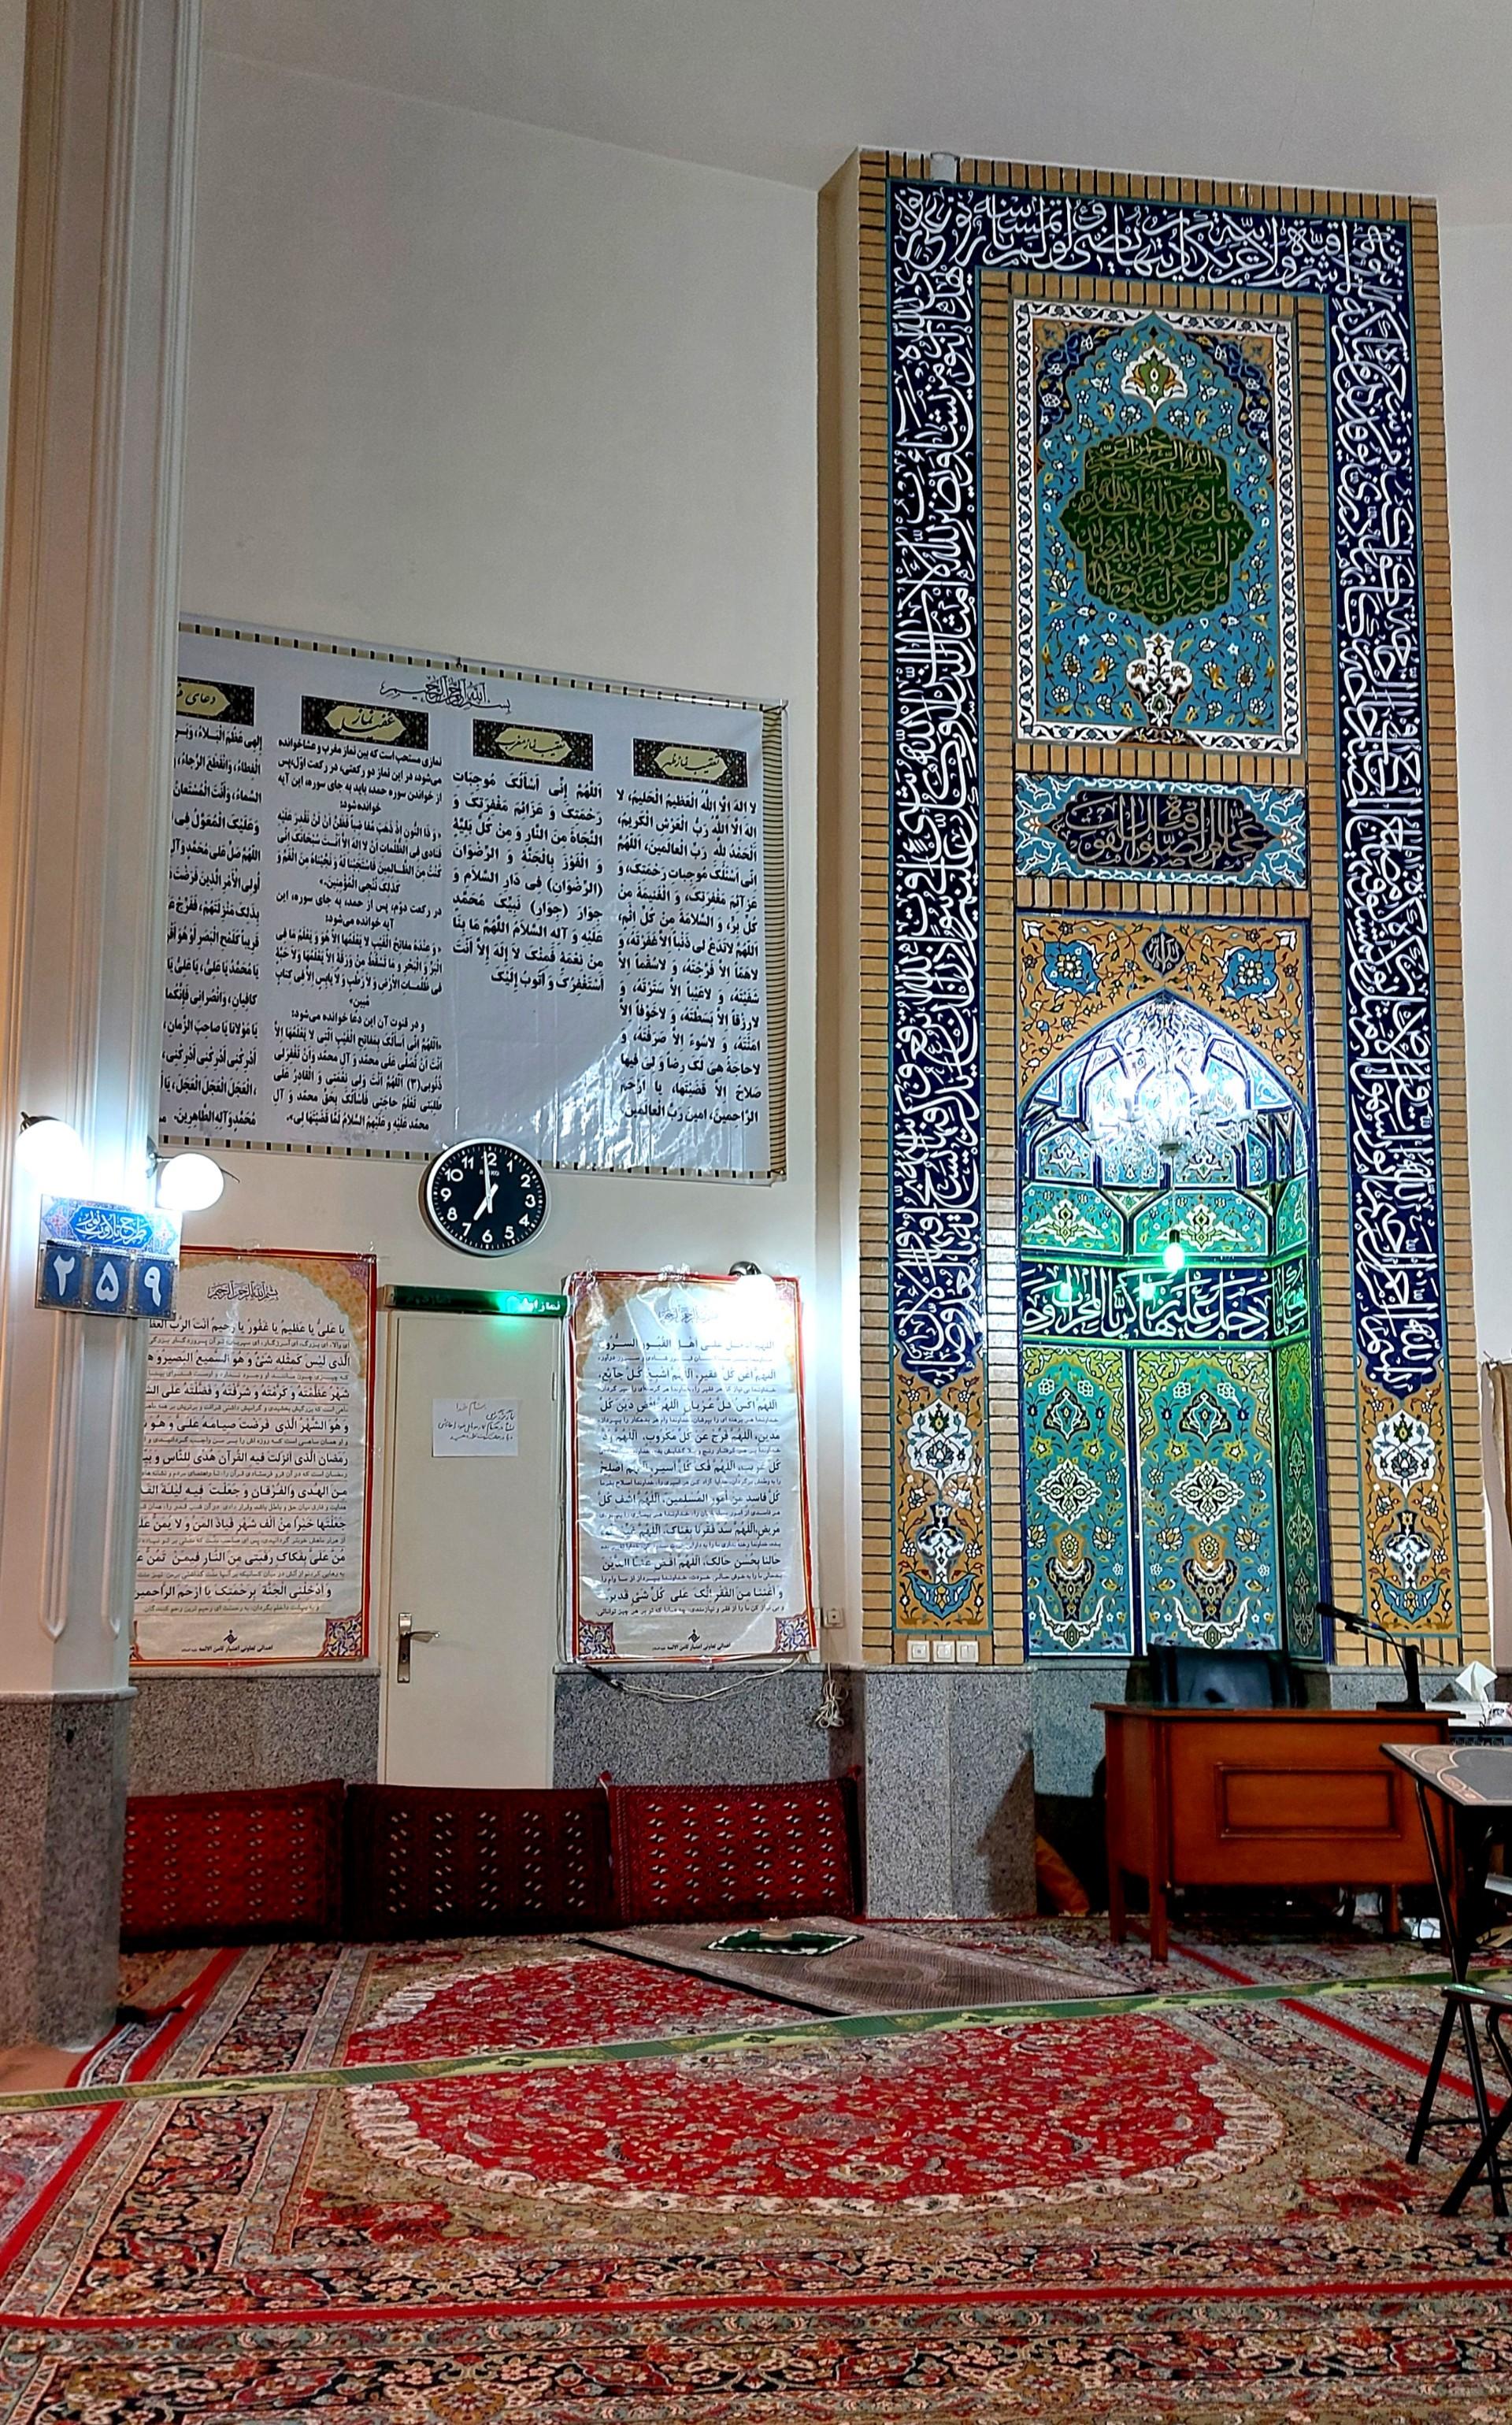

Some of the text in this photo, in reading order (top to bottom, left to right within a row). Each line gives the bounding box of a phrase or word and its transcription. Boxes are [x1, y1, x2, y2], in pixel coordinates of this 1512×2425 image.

[324, 744, 342, 755] مغرب
[343, 745, 356, 758] نماز
[357, 751, 369, 759] بین
[370, 749, 378, 758] که
[380, 750, 395, 760] است
[330, 764, 338, 773] در
[421, 757, 442, 768] نمازی
[278, 773, 290, 785] آیه
[377, 767, 390, 779] نماز
[391, 769, 403, 781] این
[405, 773, 413, 783] در
[291, 776, 303, 787] این
[328, 780, 343, 792] جای
[345, 783, 352, 793] به
[354, 783, 367, 795] باید
[389, 789, 406, 799] سوره
[407, 792, 433, 803] خواندن
[435, 792, 442, 804] از
[358, 802, 381, 814] خوانده
[276, 890, 289, 901] این
[316, 894, 332, 906] جای
[335, 899, 342, 909] به
[367, 899, 373, 911] از
[376, 904, 388, 914] پس
[410, 905, 431, 917] رکعت
[433, 908, 442, 918] در
[356, 917, 381, 929] خوانده
[383, 918, 395, 930] آیه
[323, 1012, 348, 1025] خوانده
[350, 1013, 362, 1024] دعا
[364, 1014, 376, 1027] این
[377, 1014, 388, 1028] آن
[410, 1021, 419, 1031] در
[461, 1155, 474, 1170] 11
[506, 1159, 513, 1173] 1
[444, 1169, 464, 1182] 10
[521, 1174, 531, 1188] 2
[440, 1188, 451, 1202] 9
[524, 1194, 536, 1208] 3
[447, 1207, 458, 1222] 8
[518, 1213, 530, 1227] 4
[461, 1222, 472, 1237] 7
[504, 1225, 514, 1240] 5
[482, 1229, 493, 1243] 6
